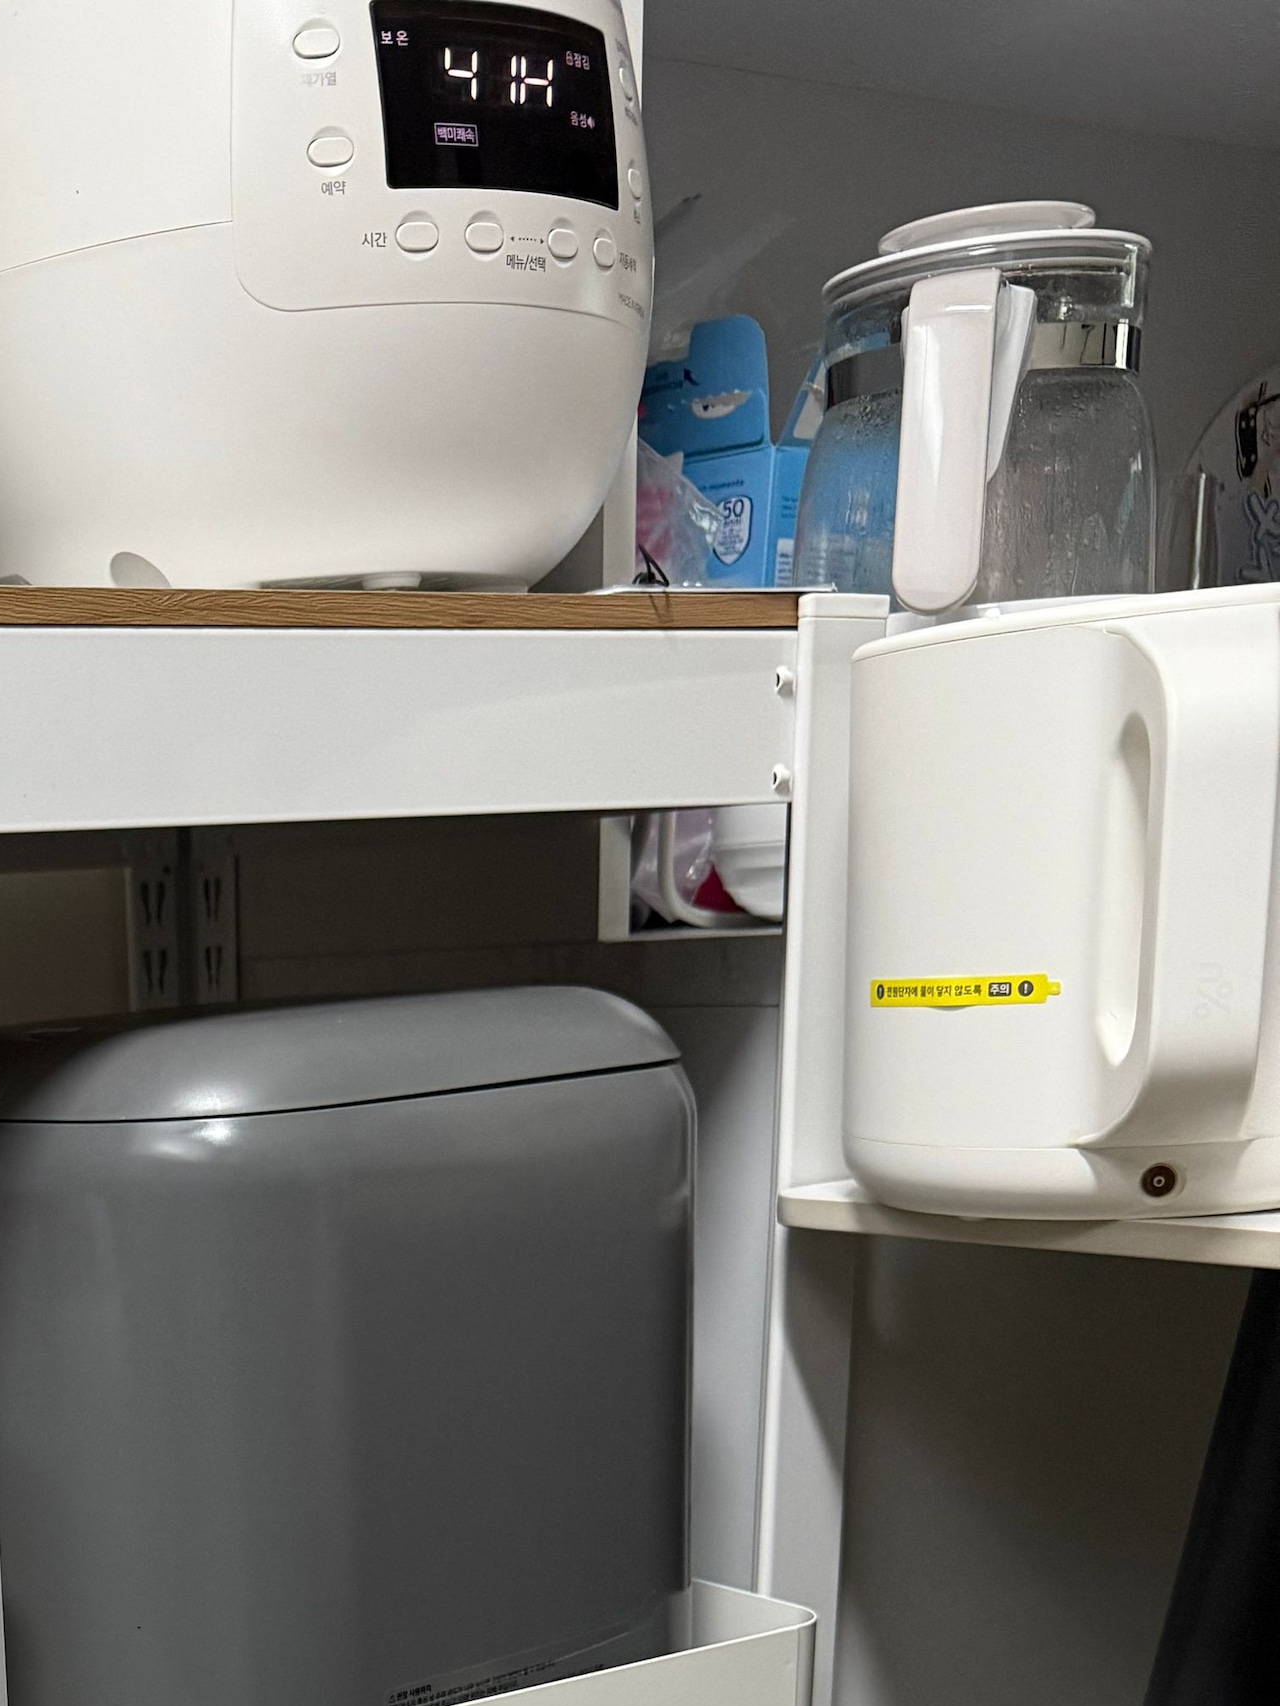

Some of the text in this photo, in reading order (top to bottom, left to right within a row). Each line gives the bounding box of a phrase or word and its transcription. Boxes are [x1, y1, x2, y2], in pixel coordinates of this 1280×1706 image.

[381, 30, 409, 46] 보온
[321, 180, 346, 196] 예약
[361, 232, 387, 248] 시간
[505, 254, 547, 272] 메뉴/선택
[954, 984, 982, 997] 않도록
[990, 983, 1010, 995] 주의
